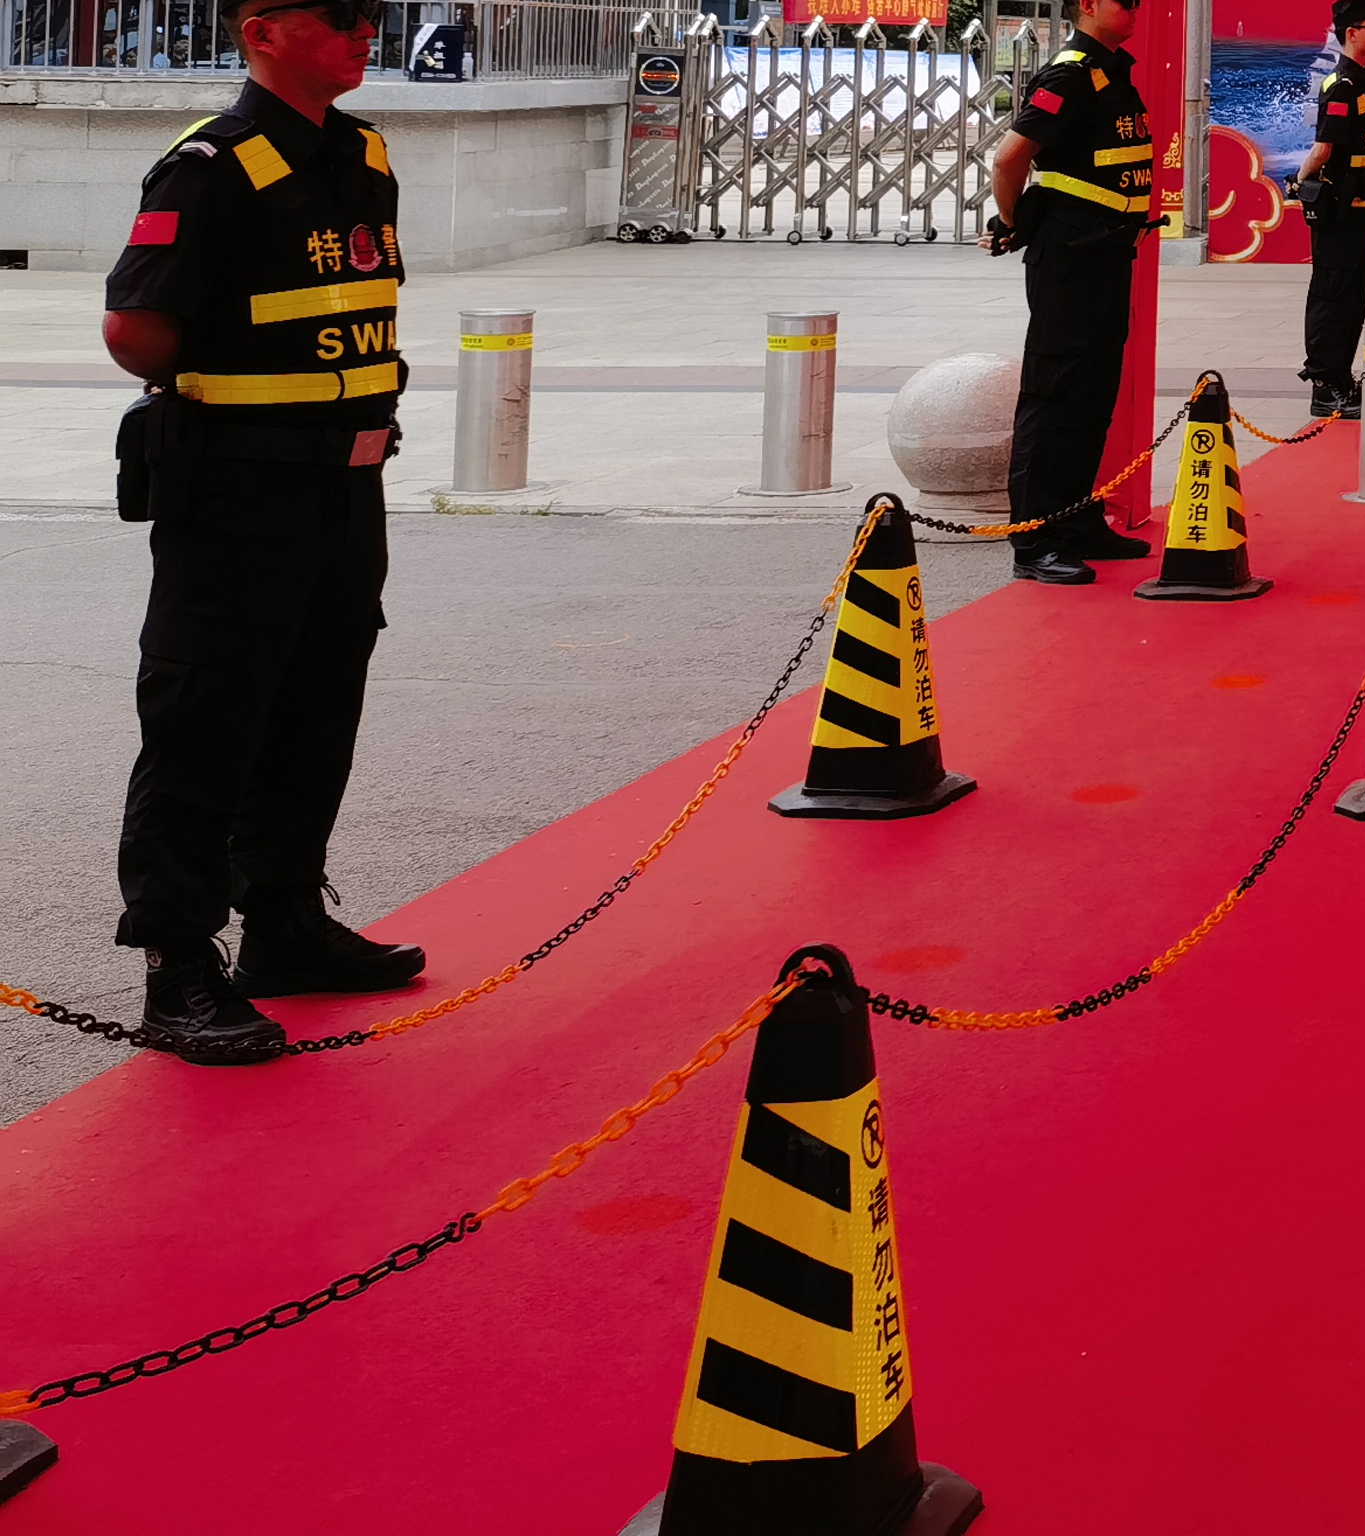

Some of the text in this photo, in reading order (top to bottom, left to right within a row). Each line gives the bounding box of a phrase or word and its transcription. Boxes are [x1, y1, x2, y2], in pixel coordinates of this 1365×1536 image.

[1184, 458, 1213, 545] 请勿泊车
[910, 616, 936, 733] 请勿泊车
[868, 1185, 905, 1405] 请勿泊车
